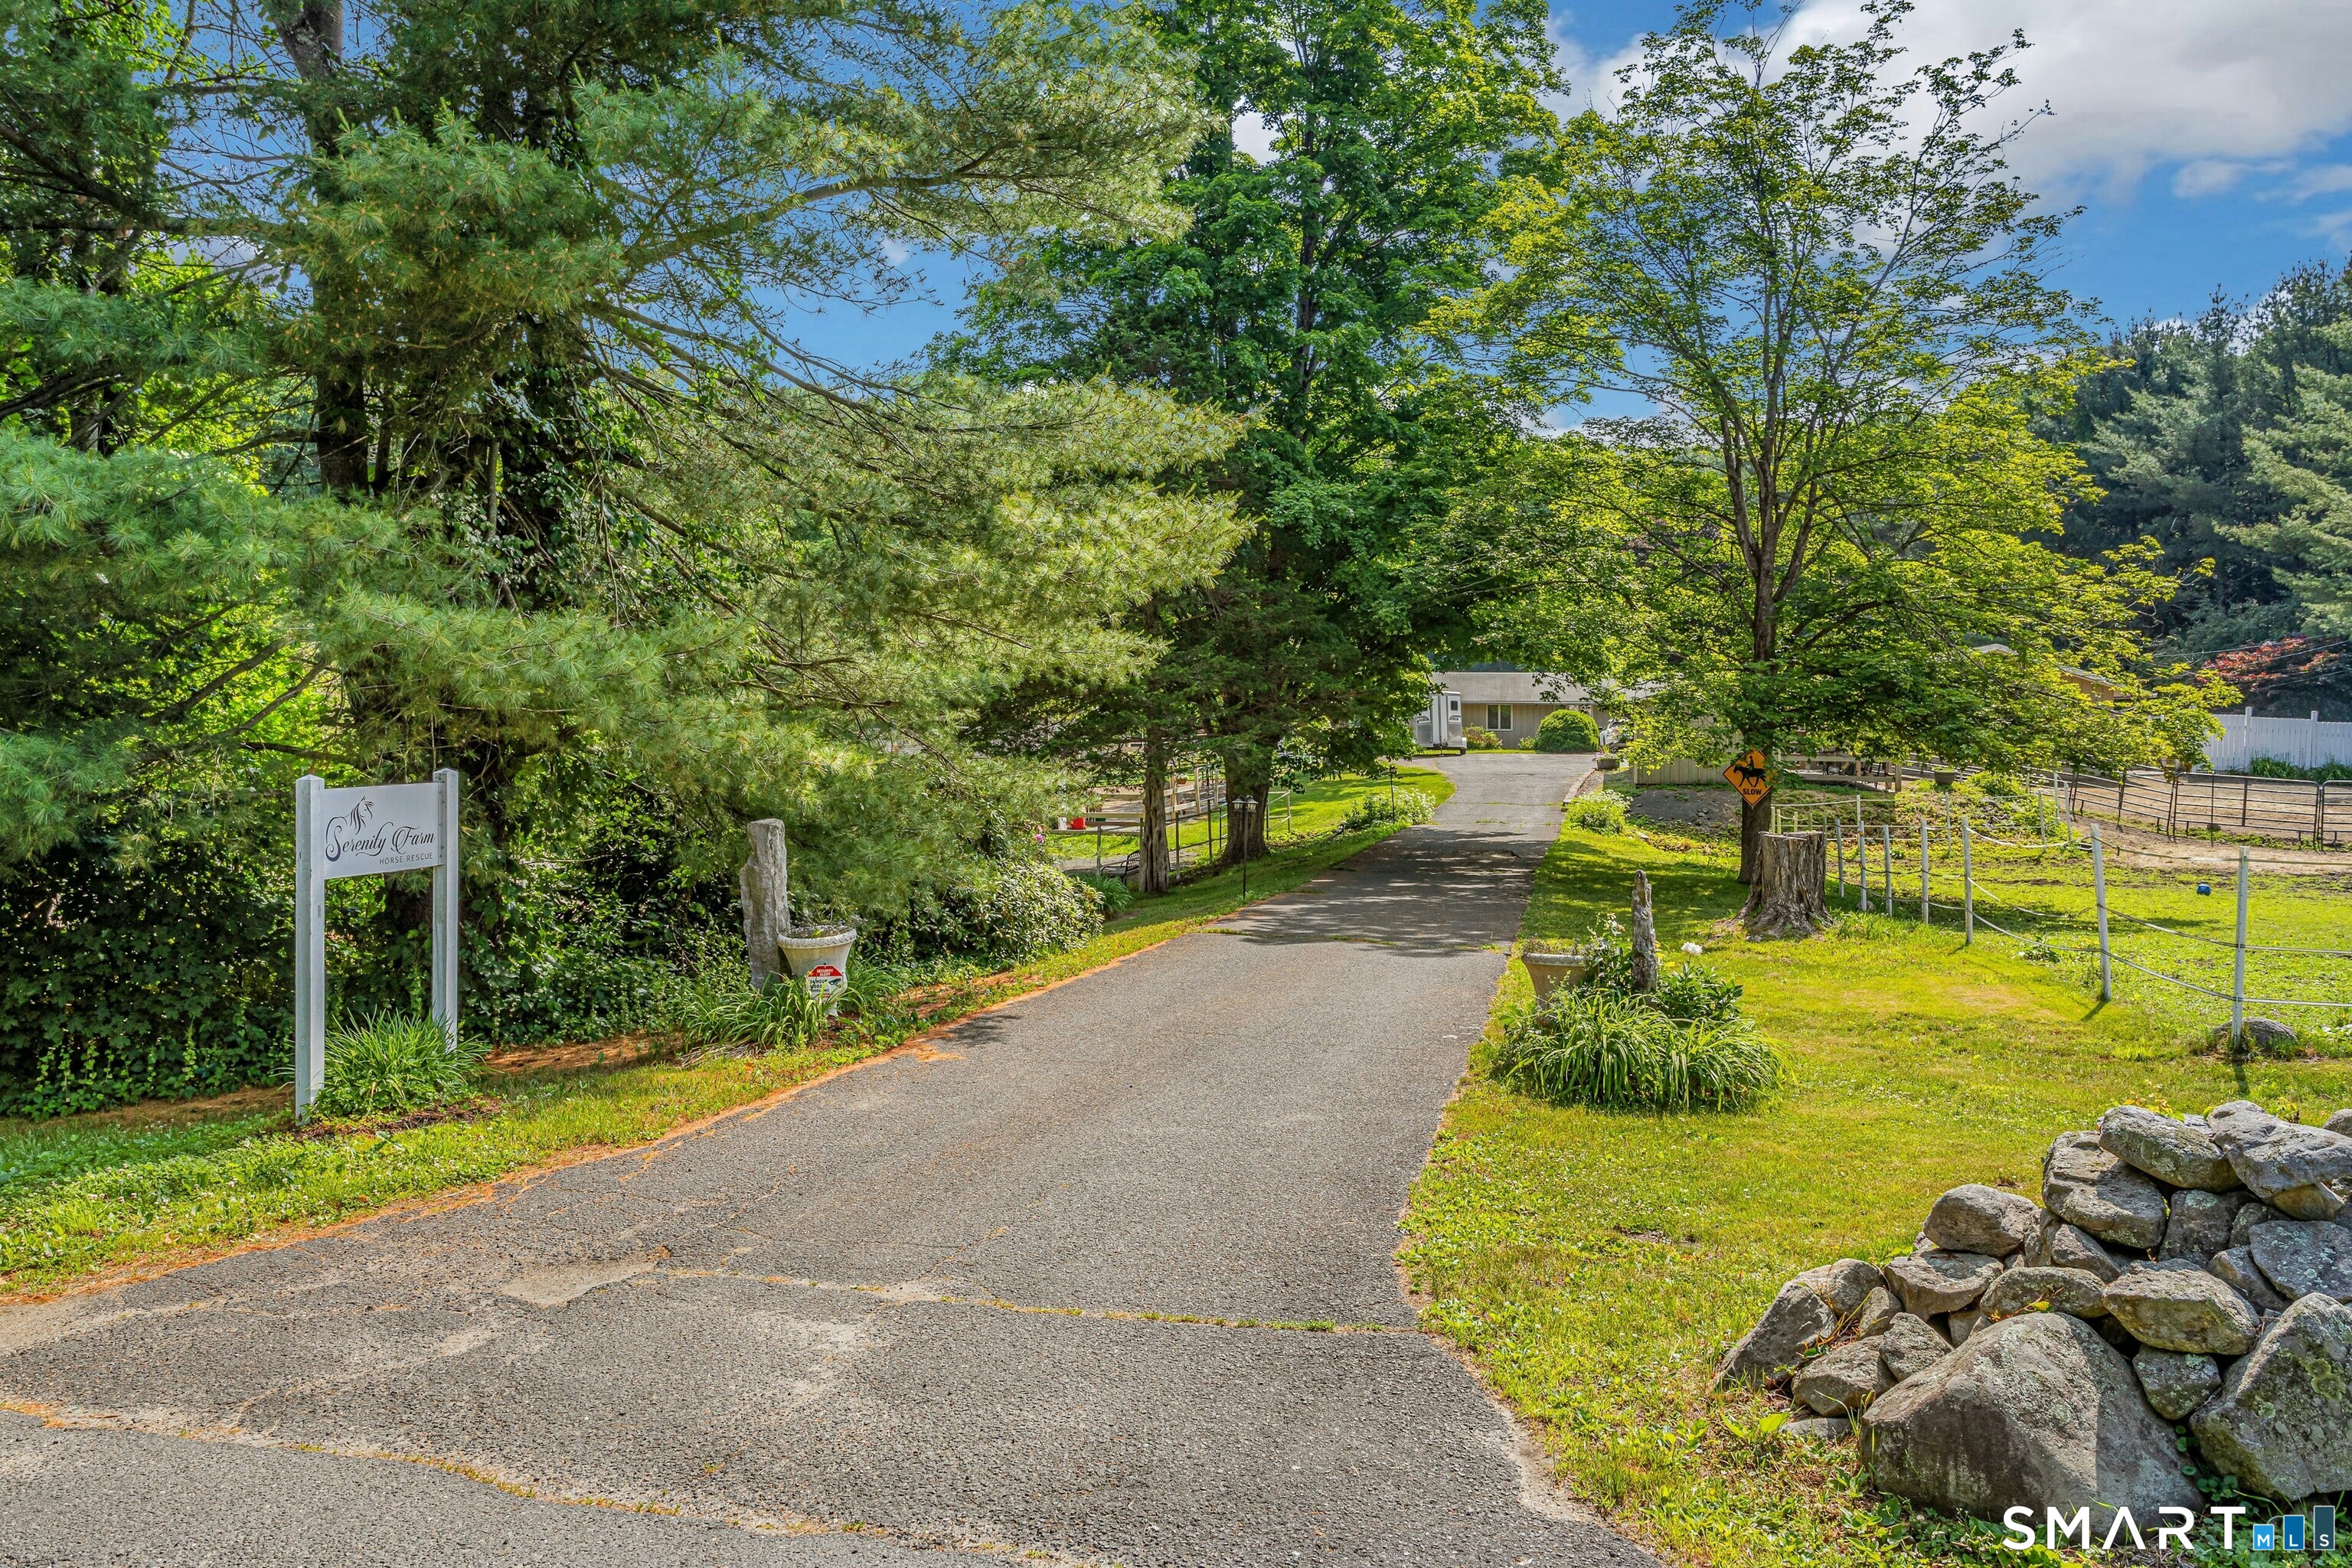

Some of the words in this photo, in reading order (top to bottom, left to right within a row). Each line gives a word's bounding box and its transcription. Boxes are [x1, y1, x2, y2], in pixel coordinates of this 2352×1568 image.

[325, 822, 394, 862] Serenity
[390, 825, 435, 854] Farm
[379, 857, 403, 865] HORSE
[407, 852, 433, 862] RESCUE
